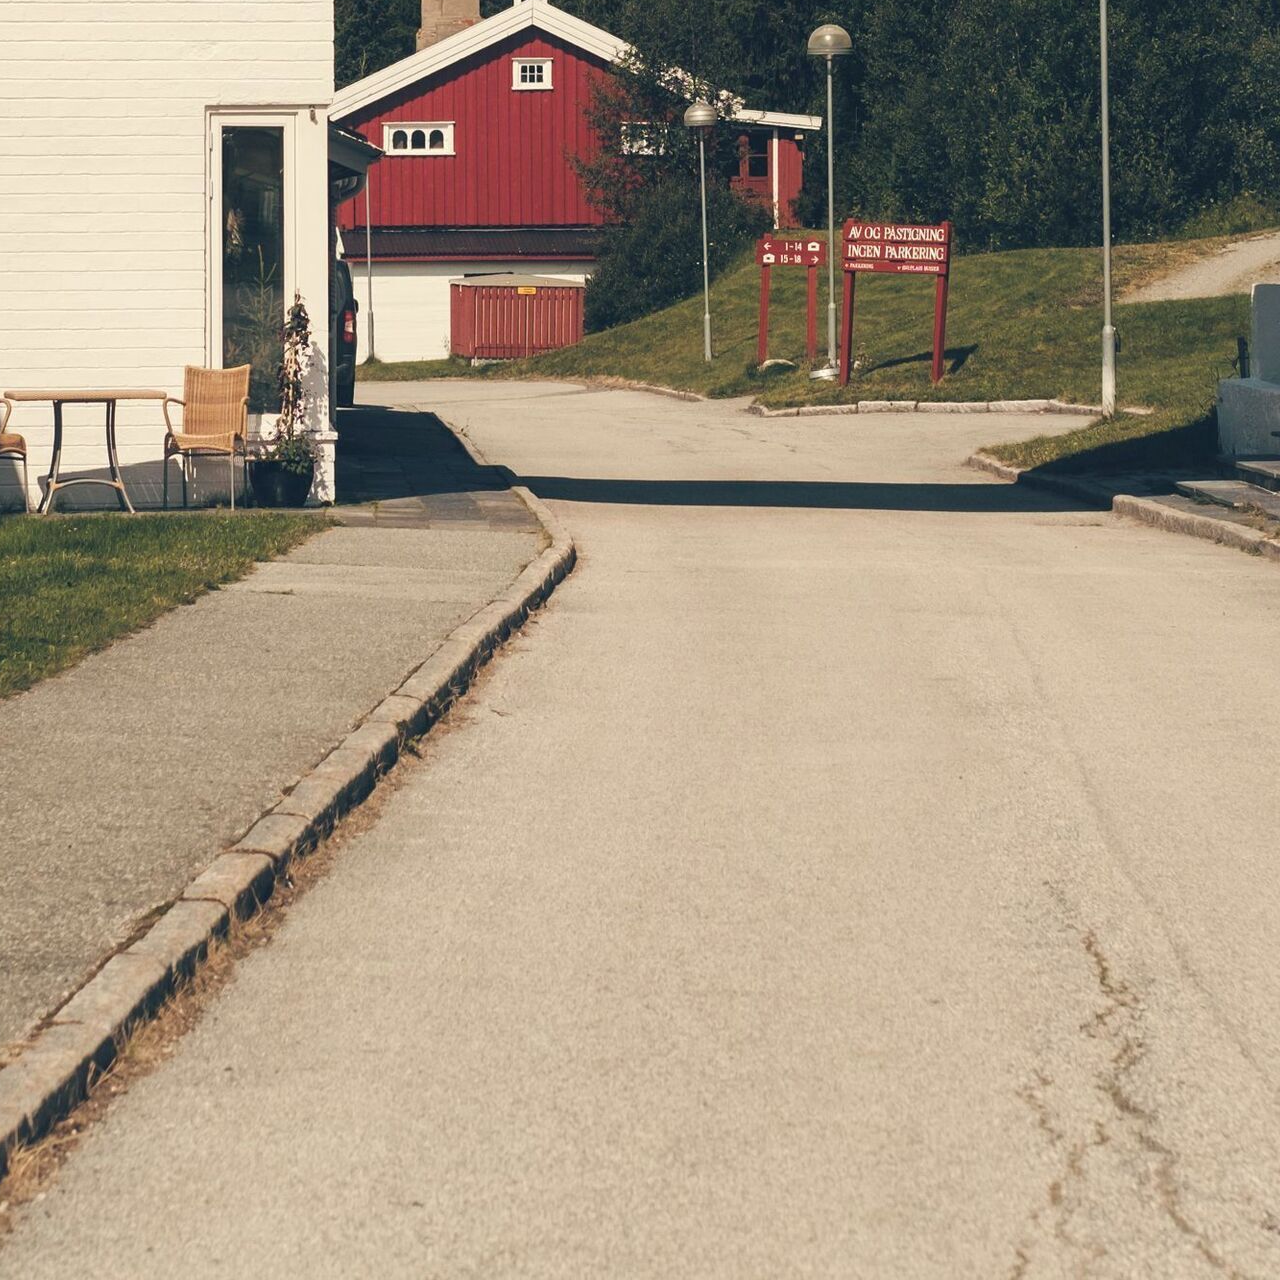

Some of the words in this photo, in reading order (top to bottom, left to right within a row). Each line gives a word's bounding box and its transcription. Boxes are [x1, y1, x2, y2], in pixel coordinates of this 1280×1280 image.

[848, 226, 862, 239] AV
[864, 226, 880, 240] OG
[884, 226, 945, 242] PÅSTIGNING
[785, 242, 802, 251] 1-14
[848, 244, 881, 258] INGEN
[885, 246, 944, 260] PARKERING
[780, 254, 802, 263] 15-18
